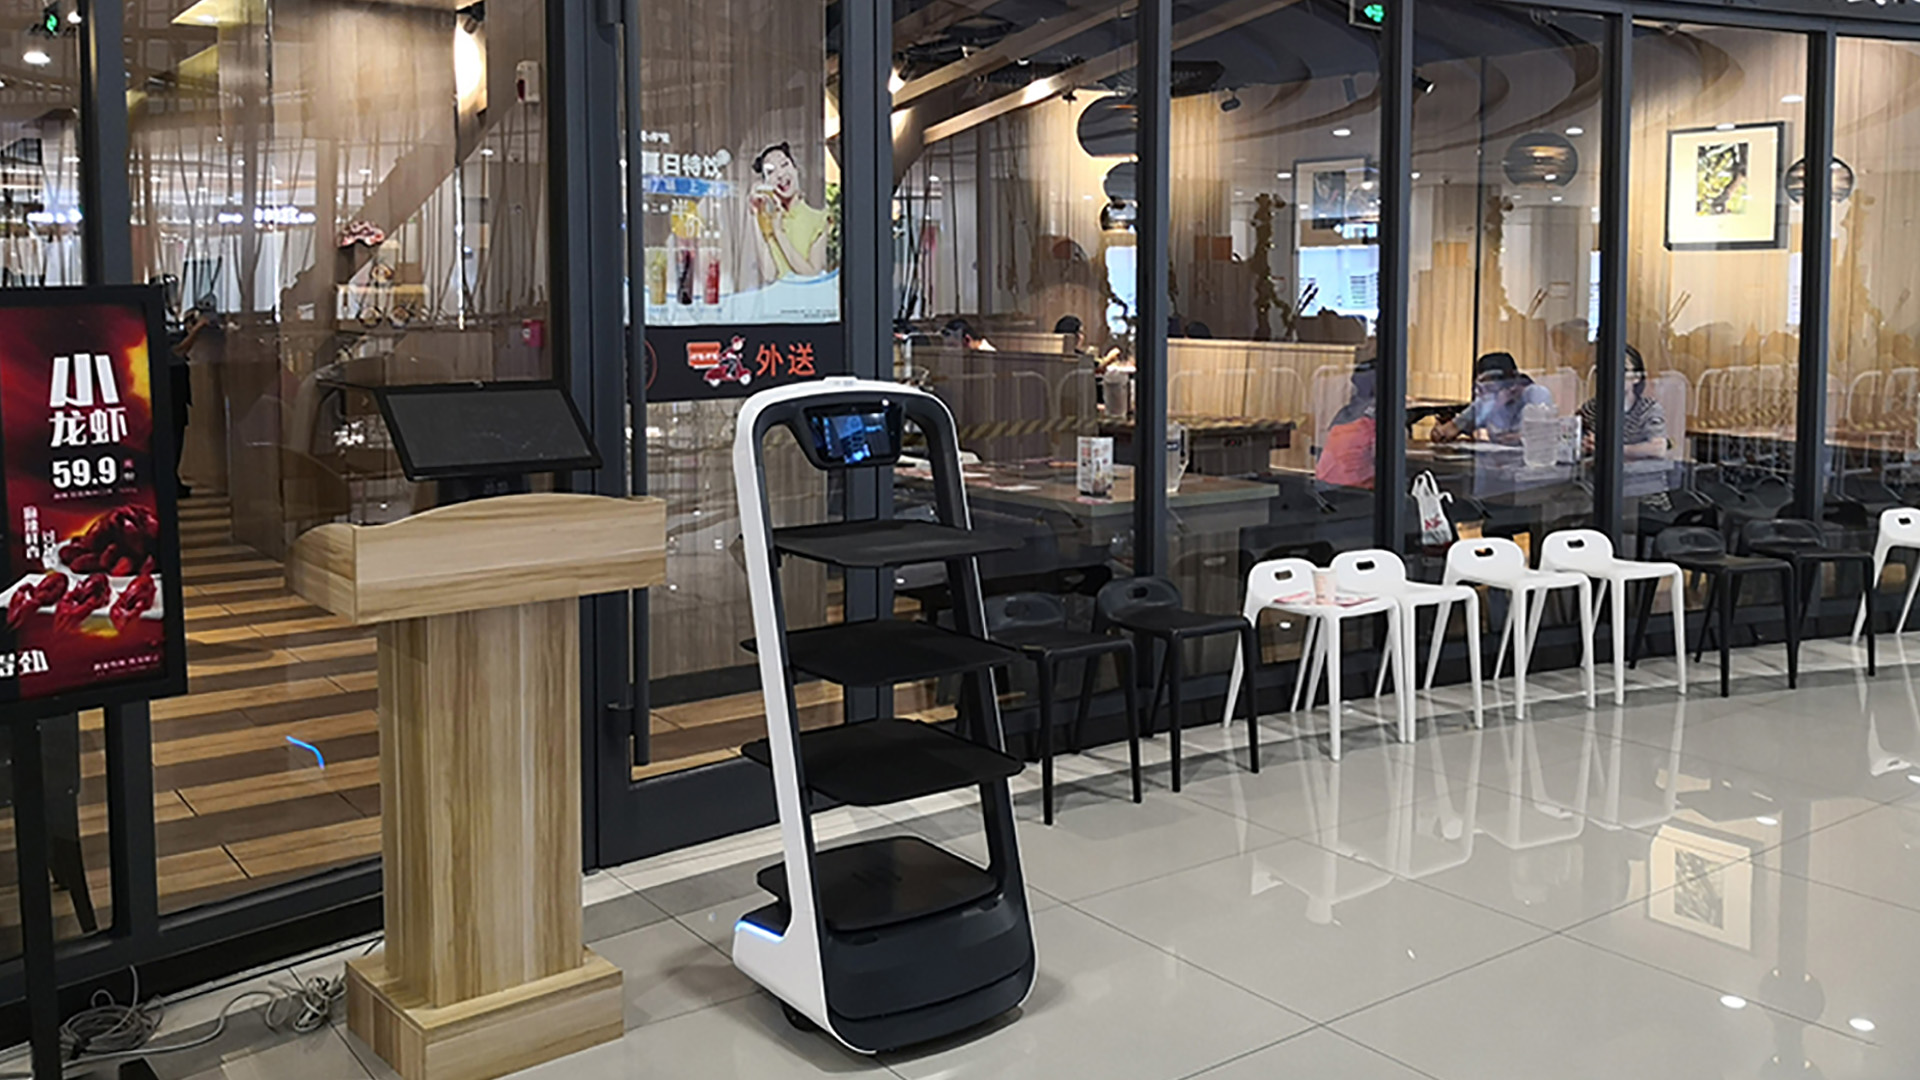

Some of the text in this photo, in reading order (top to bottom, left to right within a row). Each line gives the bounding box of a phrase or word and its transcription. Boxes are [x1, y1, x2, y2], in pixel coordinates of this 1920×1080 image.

[756, 343, 816, 377] 外送
[49, 353, 120, 407] 小
[48, 407, 127, 447] 龙虾
[52, 456, 117, 488] 59.9
